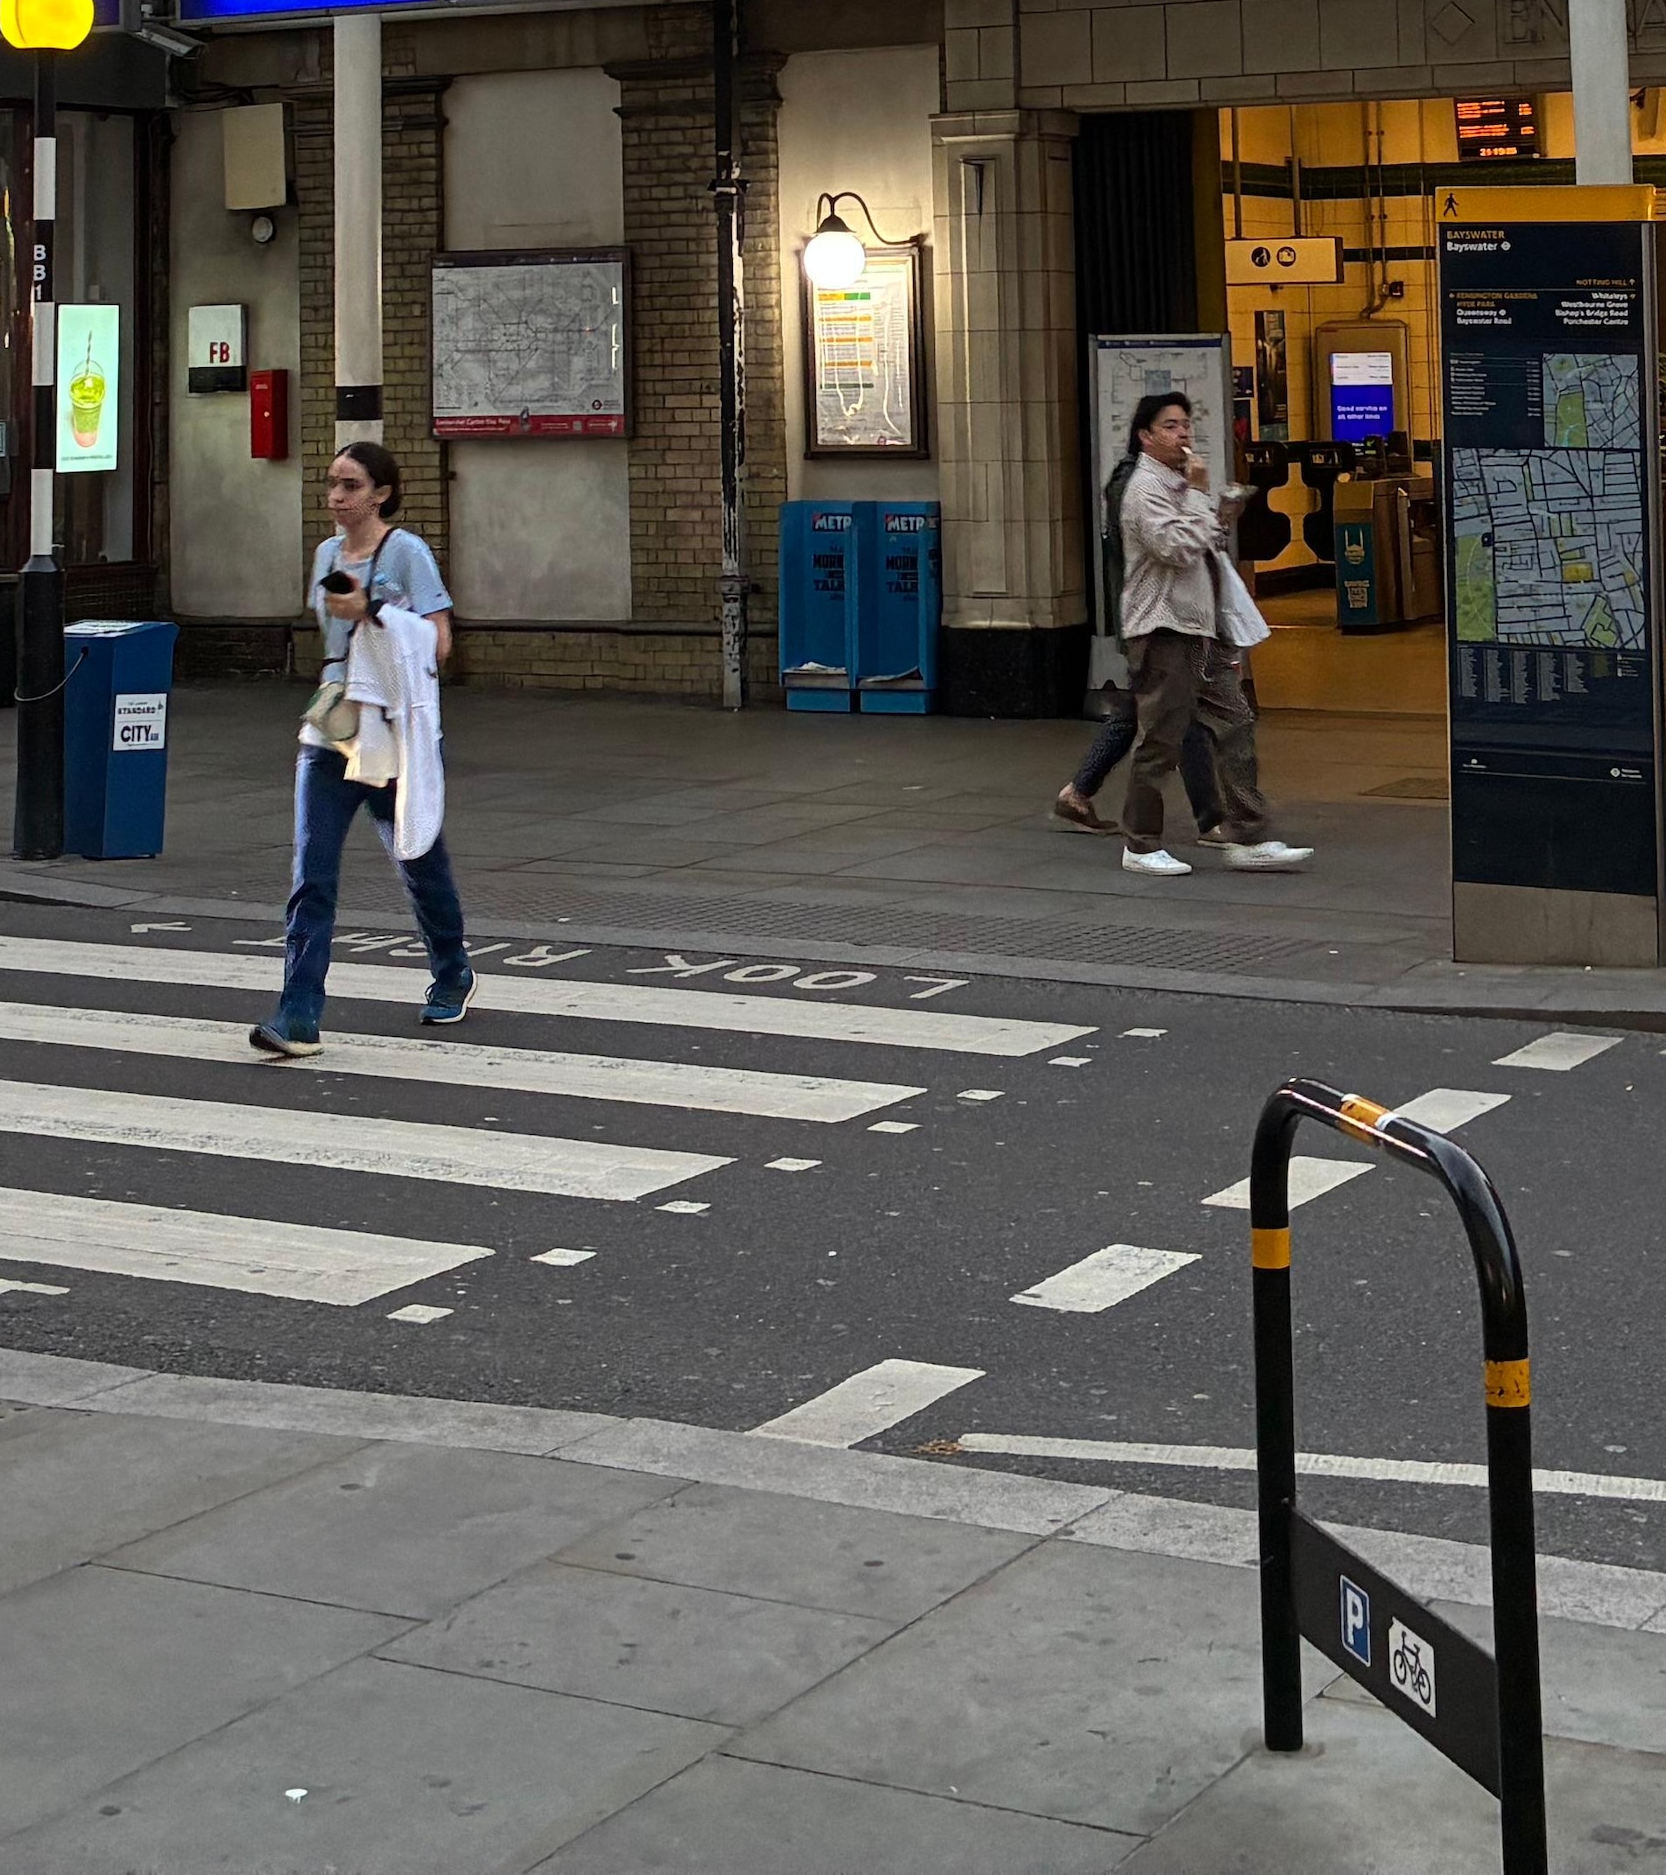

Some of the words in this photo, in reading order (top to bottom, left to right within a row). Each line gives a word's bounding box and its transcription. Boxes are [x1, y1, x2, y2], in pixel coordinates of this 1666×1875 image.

[1446, 230, 1506, 240] BAYSWATER
[1446, 241, 1498, 252] Bayswater
[209, 342, 231, 364] FB
[814, 515, 852, 530] METR
[886, 516, 925, 531] METR
[121, 725, 151, 742] CITY
[626, 952, 972, 1001] LOOK
[1345, 1586, 1364, 1647] P
